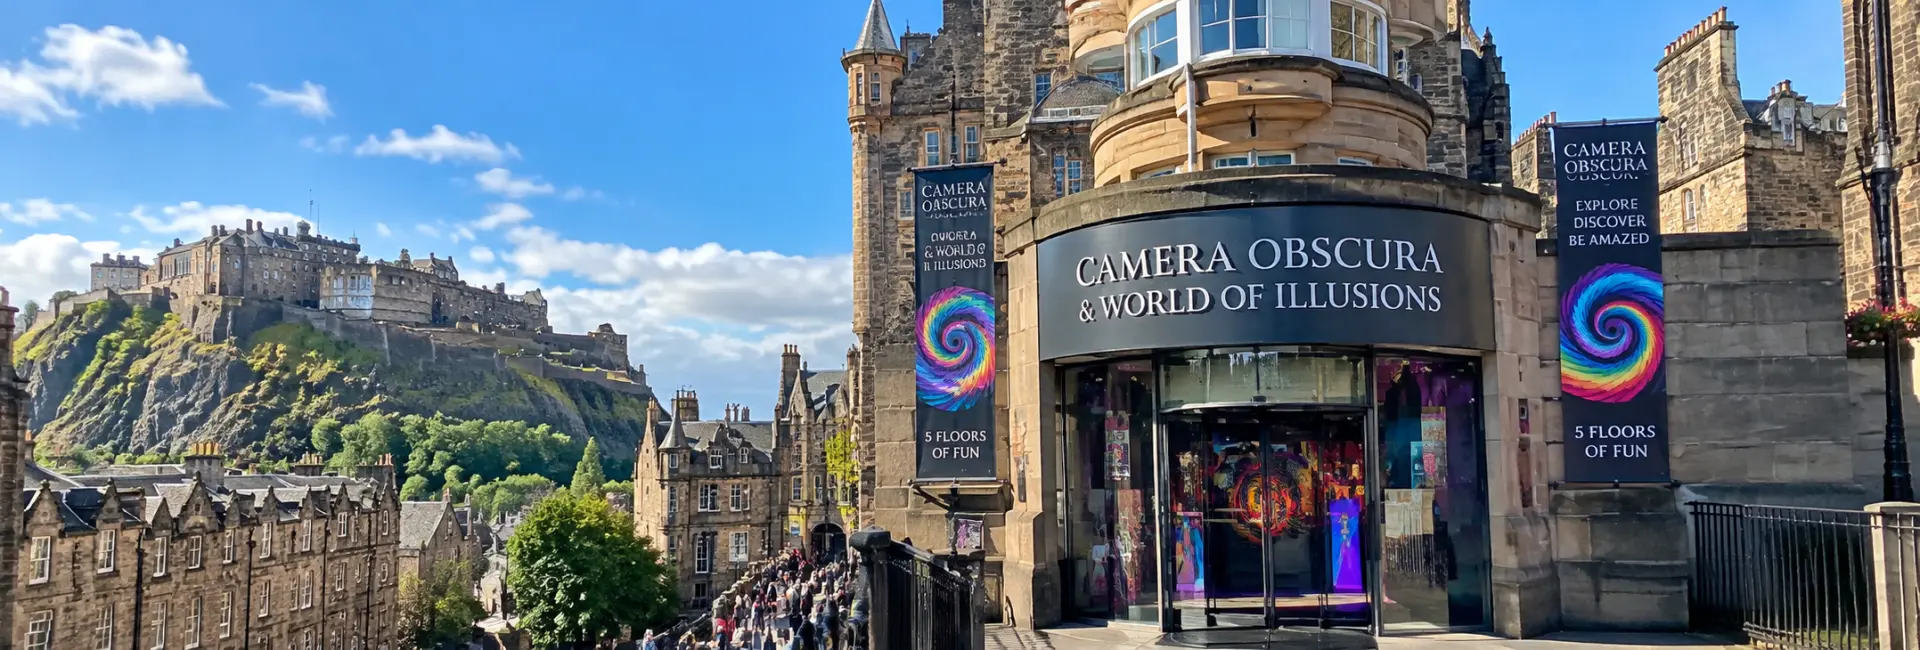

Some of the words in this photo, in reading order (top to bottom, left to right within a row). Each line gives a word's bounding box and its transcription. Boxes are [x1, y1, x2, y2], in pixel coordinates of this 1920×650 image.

[1563, 140, 1647, 158] CAMERA
[1564, 158, 1648, 174] OBSCURA
[922, 181, 986, 198] CAMERA
[1576, 198, 1638, 212] EXPLORE
[1574, 214, 1647, 229] DISCOVER
[1569, 234, 1586, 246] BE
[1589, 232, 1650, 246] AMAZED
[1076, 241, 1236, 287] CAMERA
[1248, 237, 1444, 274] OBSCURA
[1078, 298, 1095, 323] &
[1100, 286, 1211, 318] WORLD
[1220, 283, 1265, 312] OF
[1275, 282, 1442, 312] ILLUSIONS
[925, 431, 932, 443] 5
[936, 430, 987, 442] FLOORS
[1575, 425, 1584, 439] 5
[1589, 425, 1656, 438] FLOORS
[932, 447, 950, 459] OF
[953, 446, 980, 459] FUN
[1585, 444, 1608, 458] OF
[1613, 444, 1648, 458] FUN
